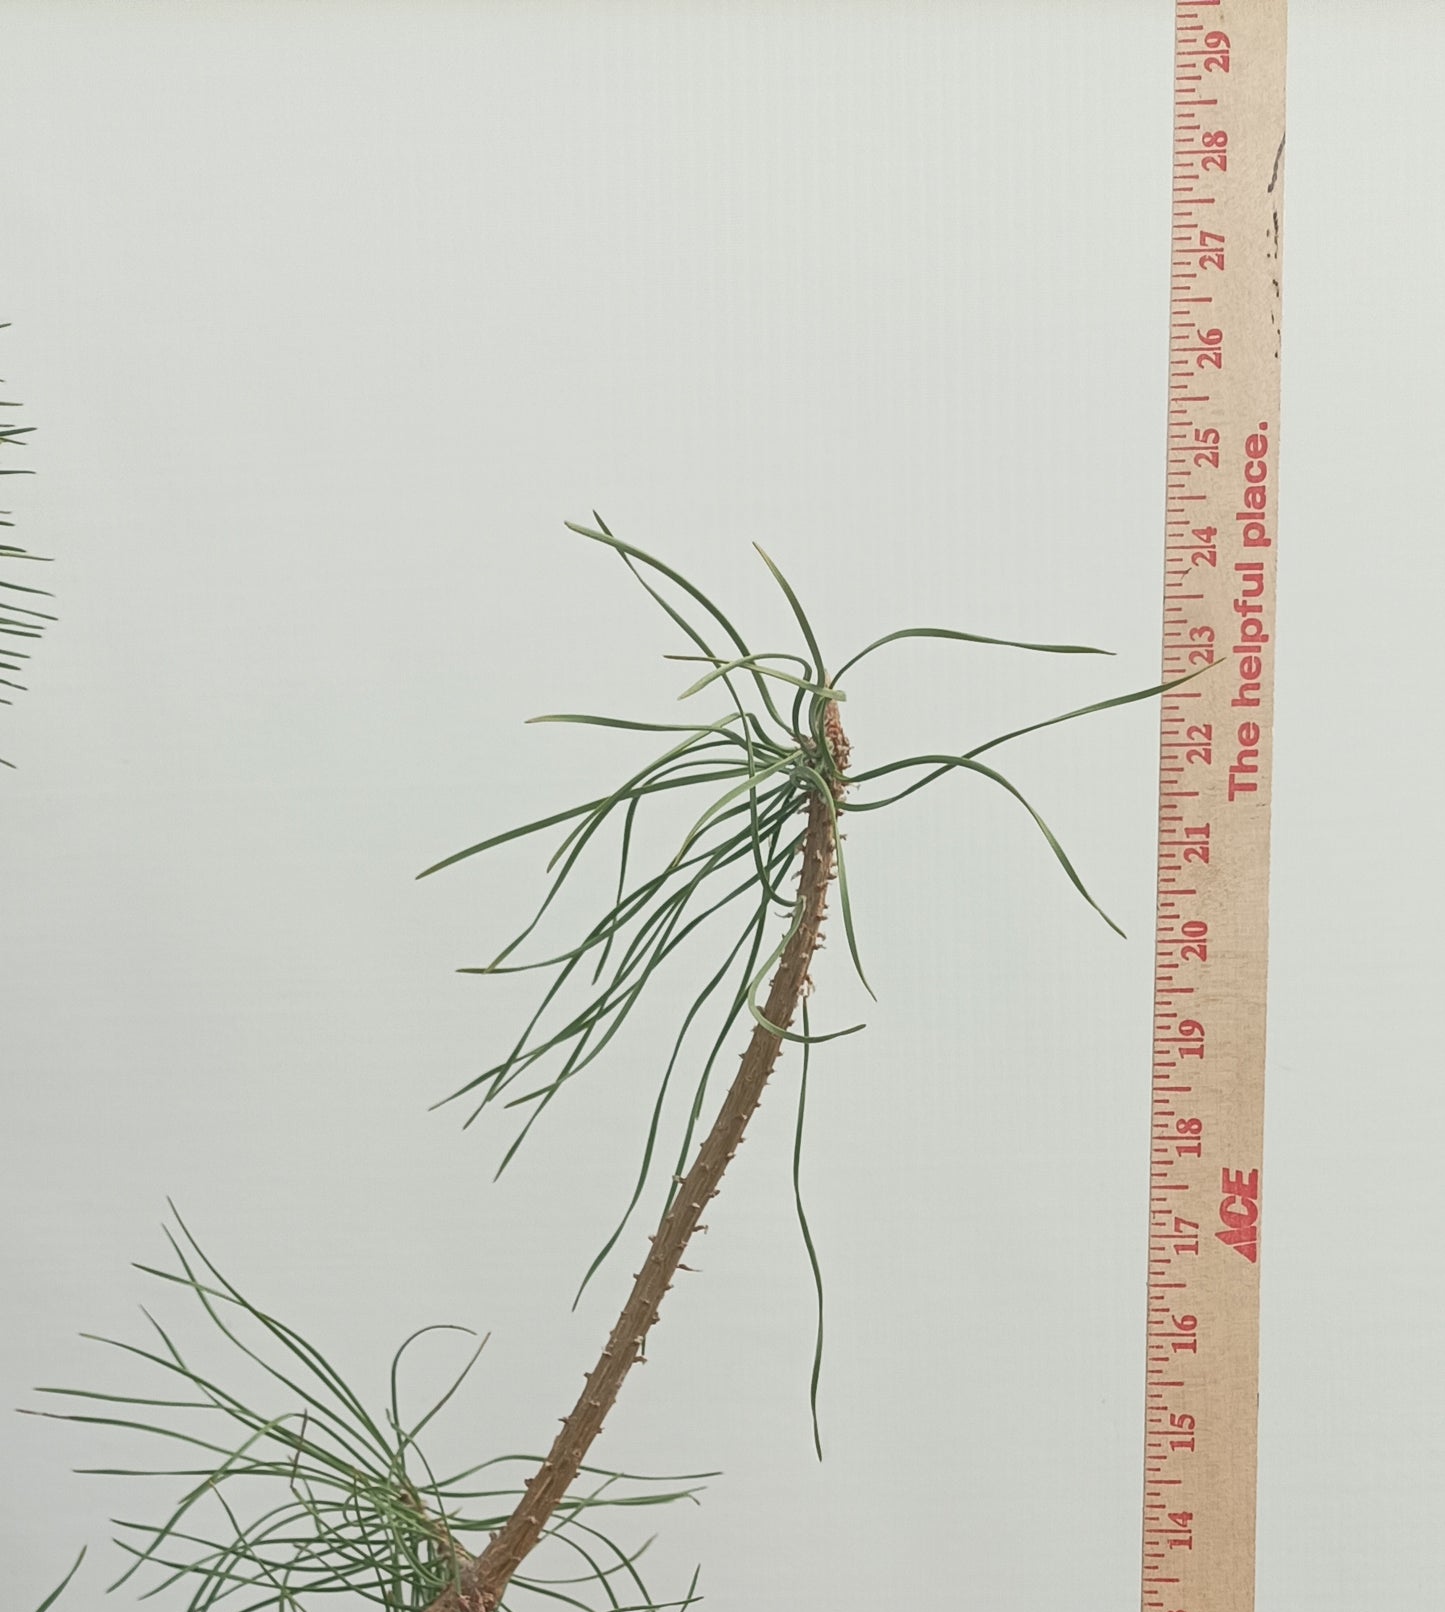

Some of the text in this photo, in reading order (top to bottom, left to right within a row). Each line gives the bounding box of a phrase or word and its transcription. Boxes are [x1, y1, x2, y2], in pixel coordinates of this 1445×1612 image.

[1204, 31, 1231, 73] 29
[1201, 130, 1228, 172] 28
[1199, 231, 1225, 271] 27
[1197, 328, 1223, 369] 26
[1194, 427, 1221, 468] 25
[1191, 526, 1217, 567] 24
[1228, 421, 1272, 802] The helpful place.
[1189, 625, 1215, 665] 23
[1186, 724, 1212, 765] 22
[1183, 822, 1210, 864] 21
[1181, 920, 1208, 962] 20
[1178, 1019, 1205, 1060] 19
[1176, 1117, 1202, 1158] 18
[1174, 1216, 1199, 1256] 17
[1215, 1167, 1259, 1264] ACE
[1171, 1314, 1198, 1354] 16
[1169, 1413, 1196, 1453] 15
[1167, 1511, 1193, 1551] 14
